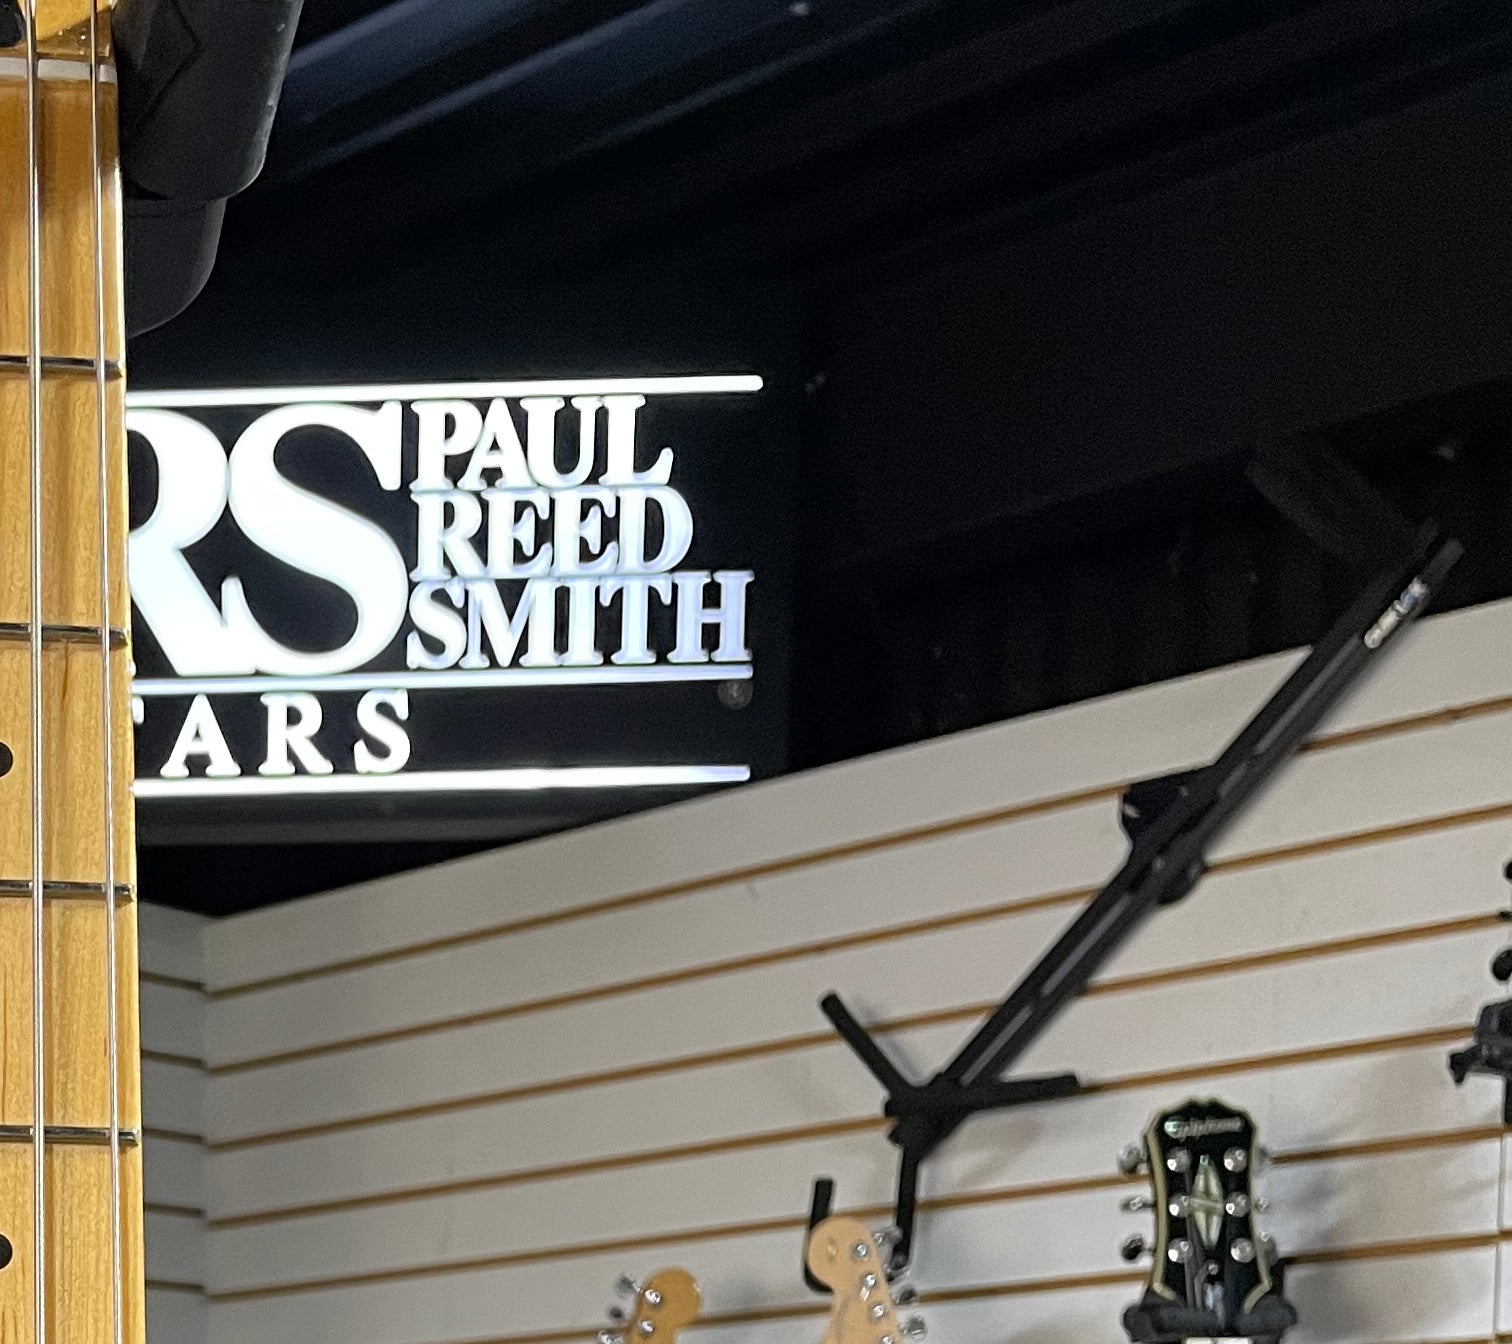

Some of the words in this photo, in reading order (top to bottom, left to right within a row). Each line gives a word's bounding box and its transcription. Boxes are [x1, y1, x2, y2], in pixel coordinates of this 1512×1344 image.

[409, 393, 674, 491] PAUL
[409, 484, 693, 580] REED
[407, 570, 755, 670] SMITH
